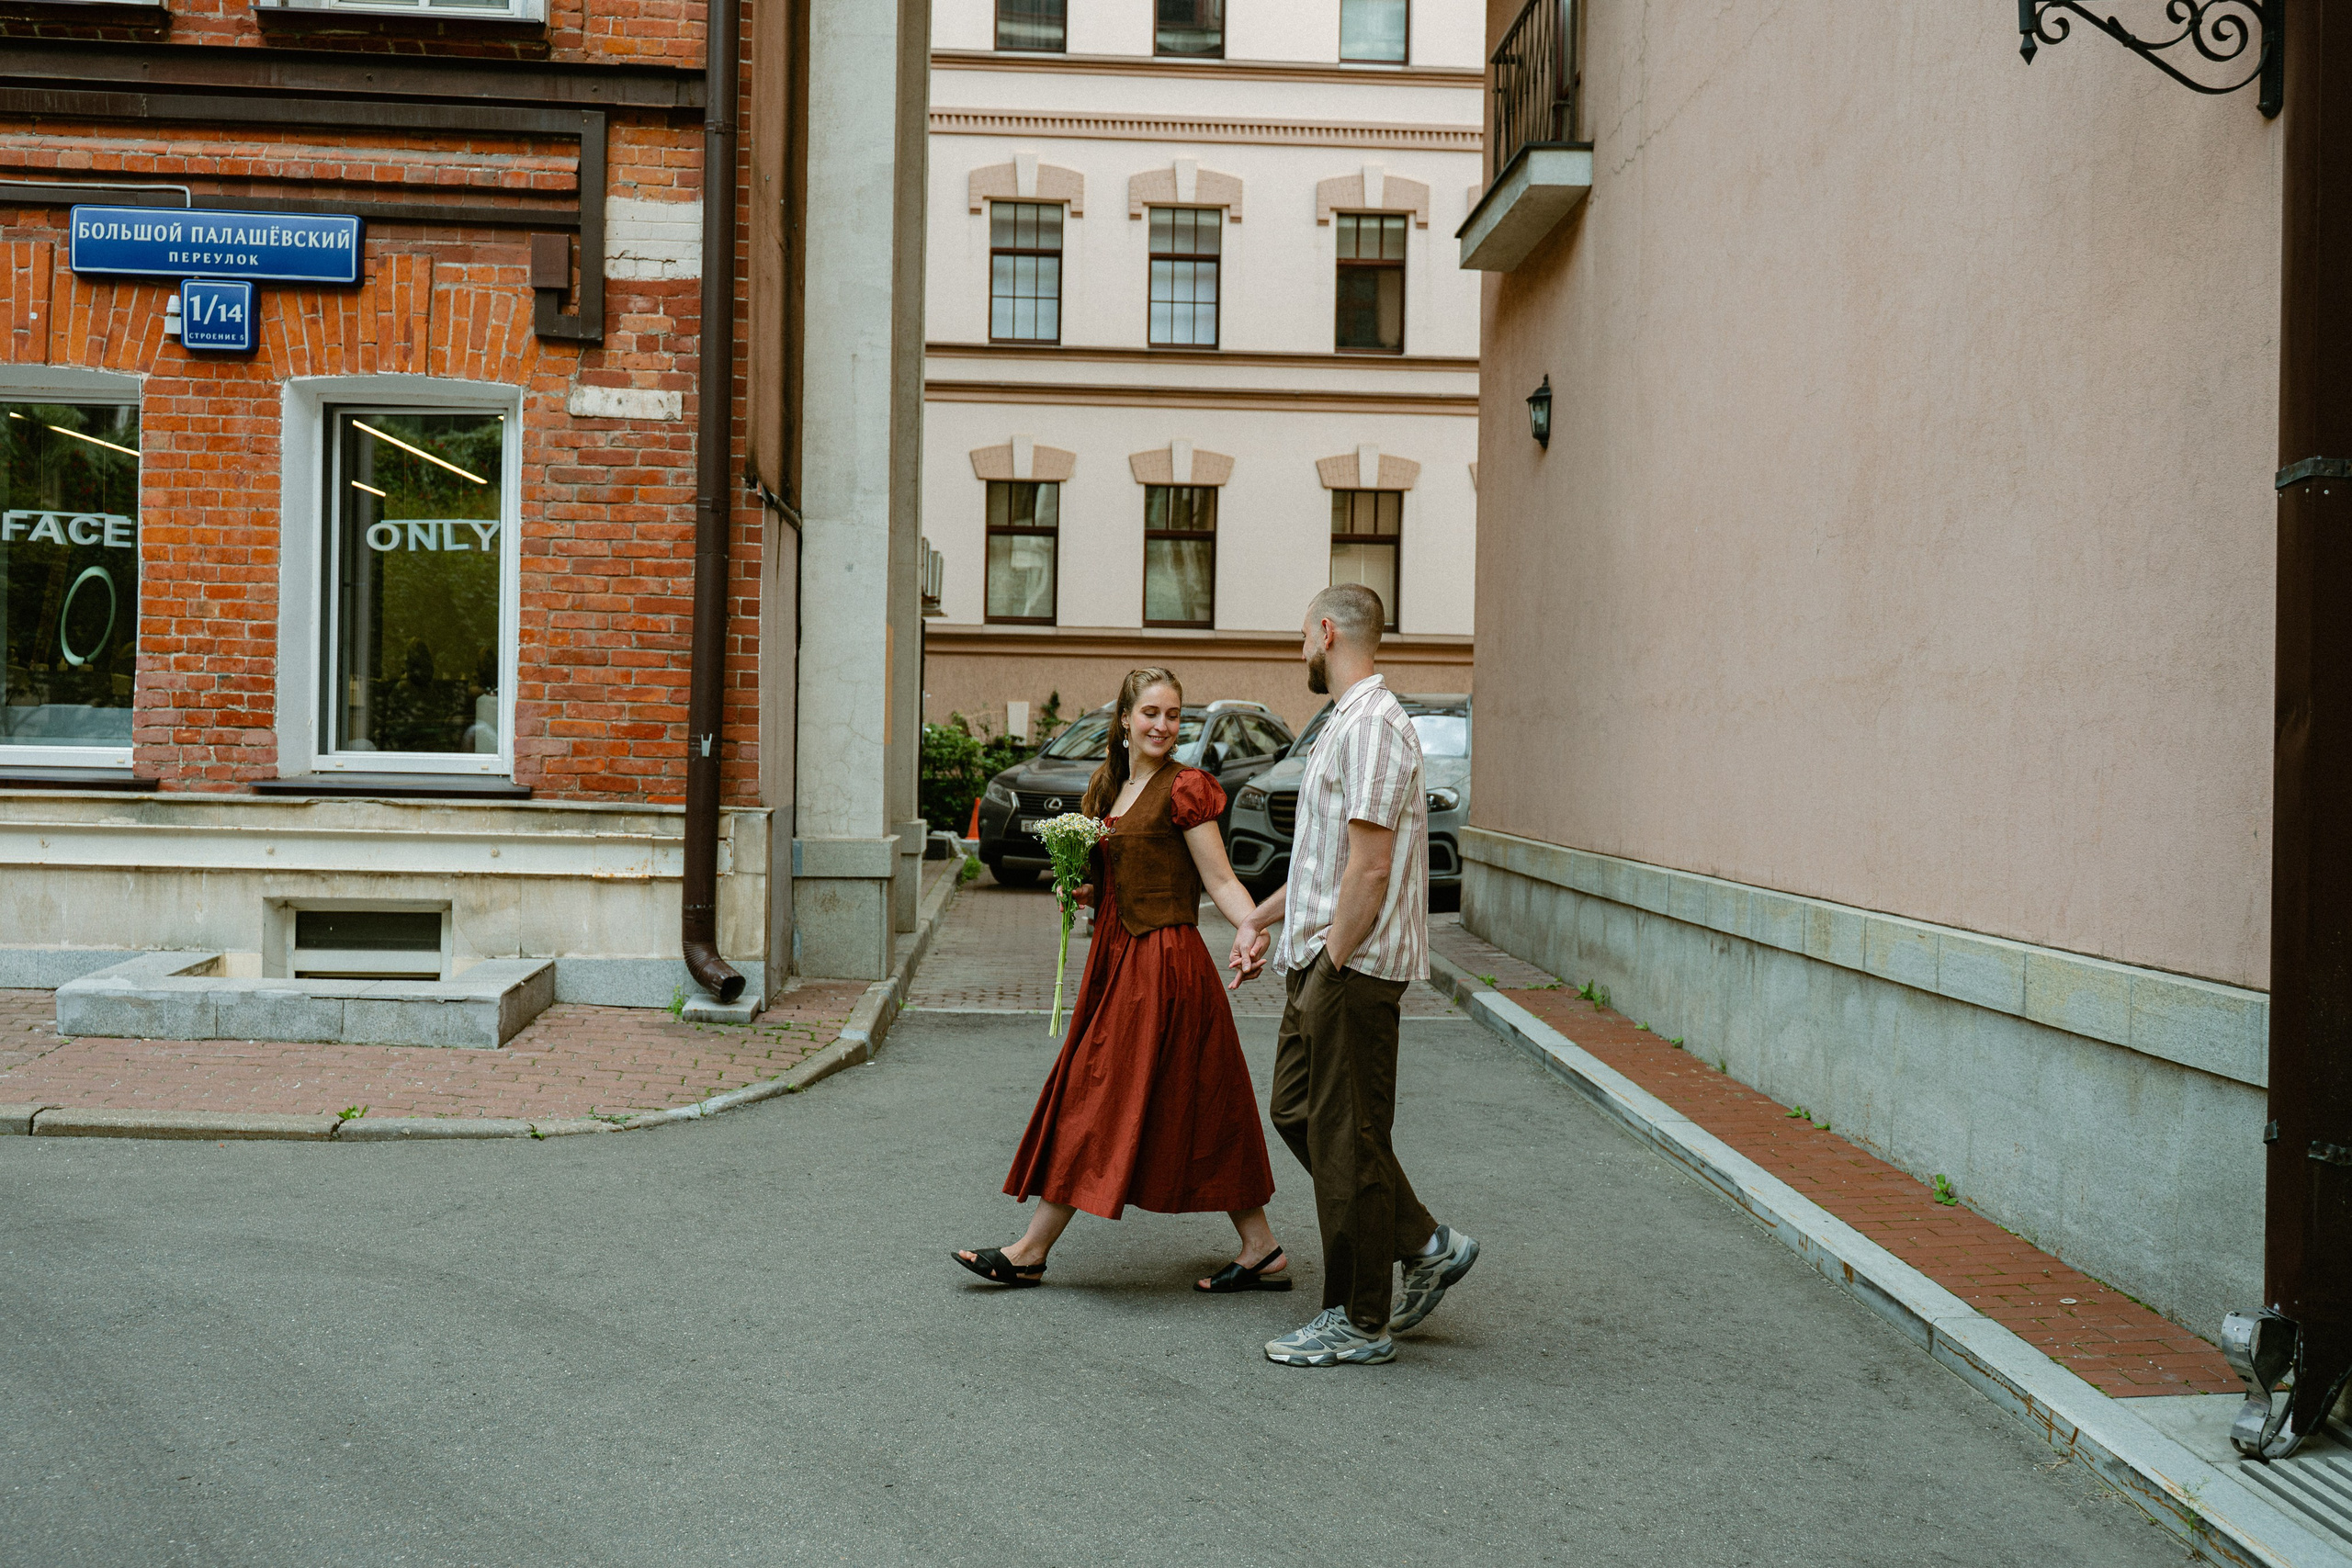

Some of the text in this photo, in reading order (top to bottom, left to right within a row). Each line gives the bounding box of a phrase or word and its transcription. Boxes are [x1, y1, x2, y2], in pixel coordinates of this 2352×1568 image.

[78, 222, 350, 249] БОЛЬШОЙ ПАЛАШЁВСКИЙ
[169, 252, 259, 265] ПЕРЕУЛОК
[189, 294, 243, 324] 1/14
[188, 332, 237, 341] СТРОЕНИЕ
[2, 510, 137, 547] FACE
[366, 519, 501, 551] ONLY
